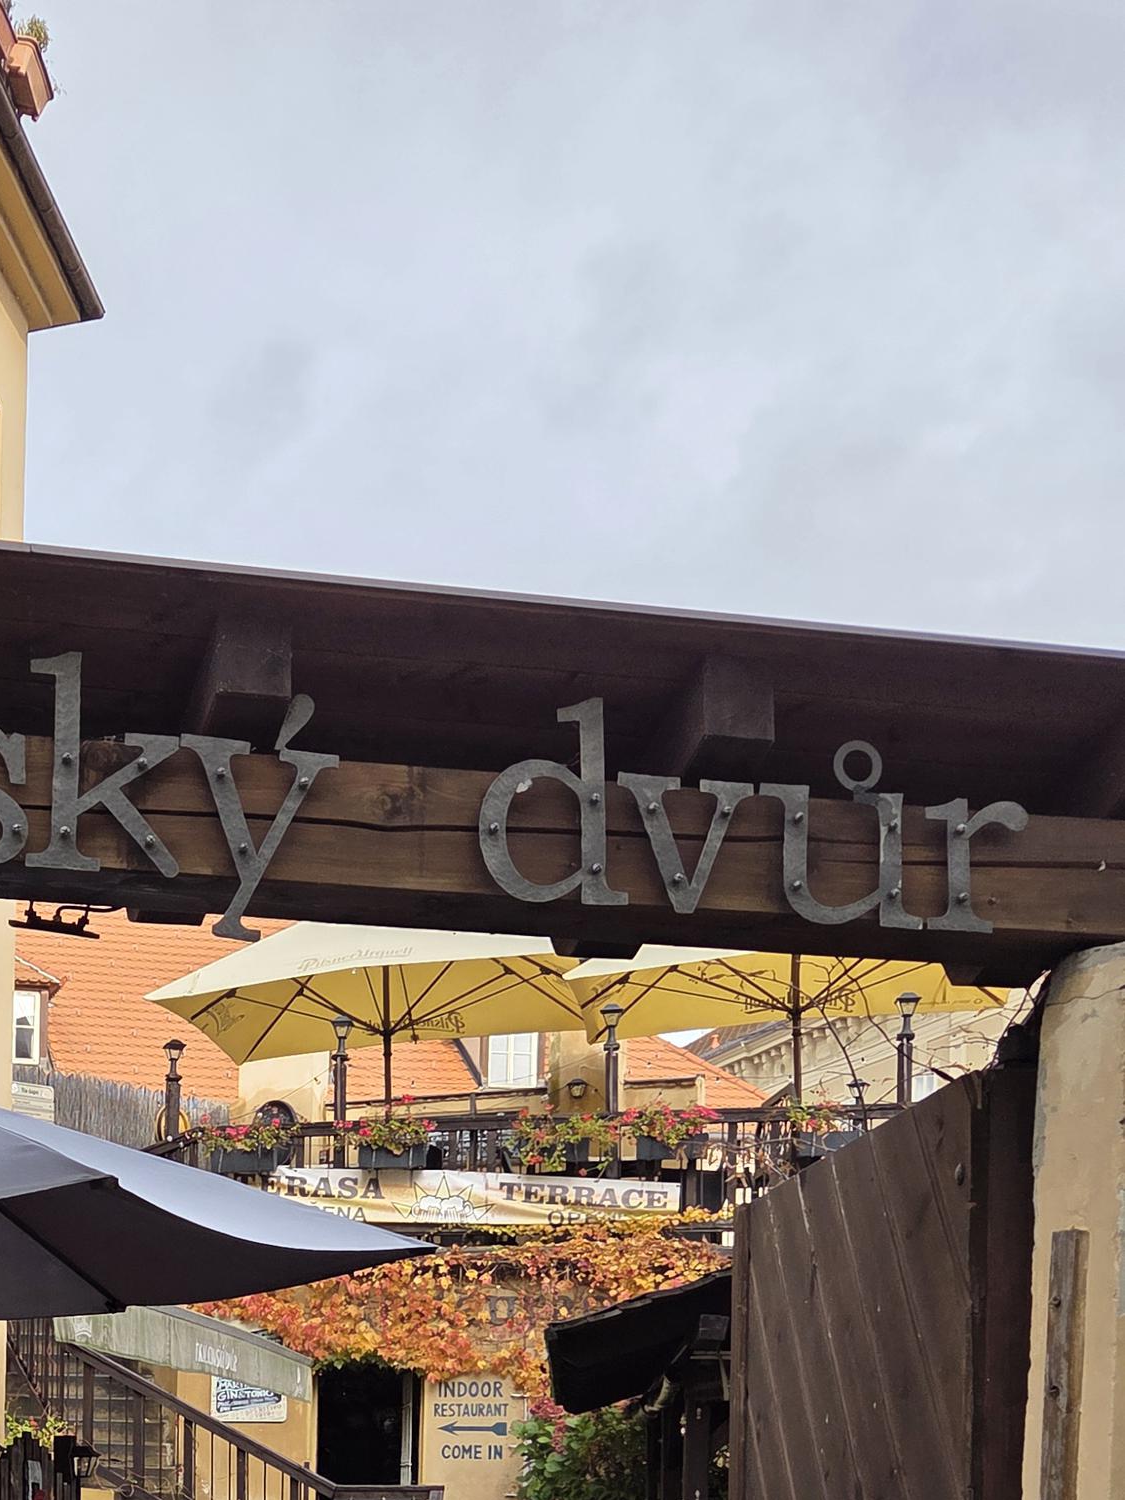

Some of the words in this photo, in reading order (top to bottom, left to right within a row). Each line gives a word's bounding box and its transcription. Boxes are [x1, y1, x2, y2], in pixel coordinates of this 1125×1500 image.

[480, 697, 1029, 933] dvůr
[499, 1181, 668, 1209] TERRACE
[438, 1381, 503, 1398] INDOOR
[433, 1403, 509, 1417] RESTAURANT
[441, 1445, 482, 1459] COME
[488, 1445, 503, 1460] IN
